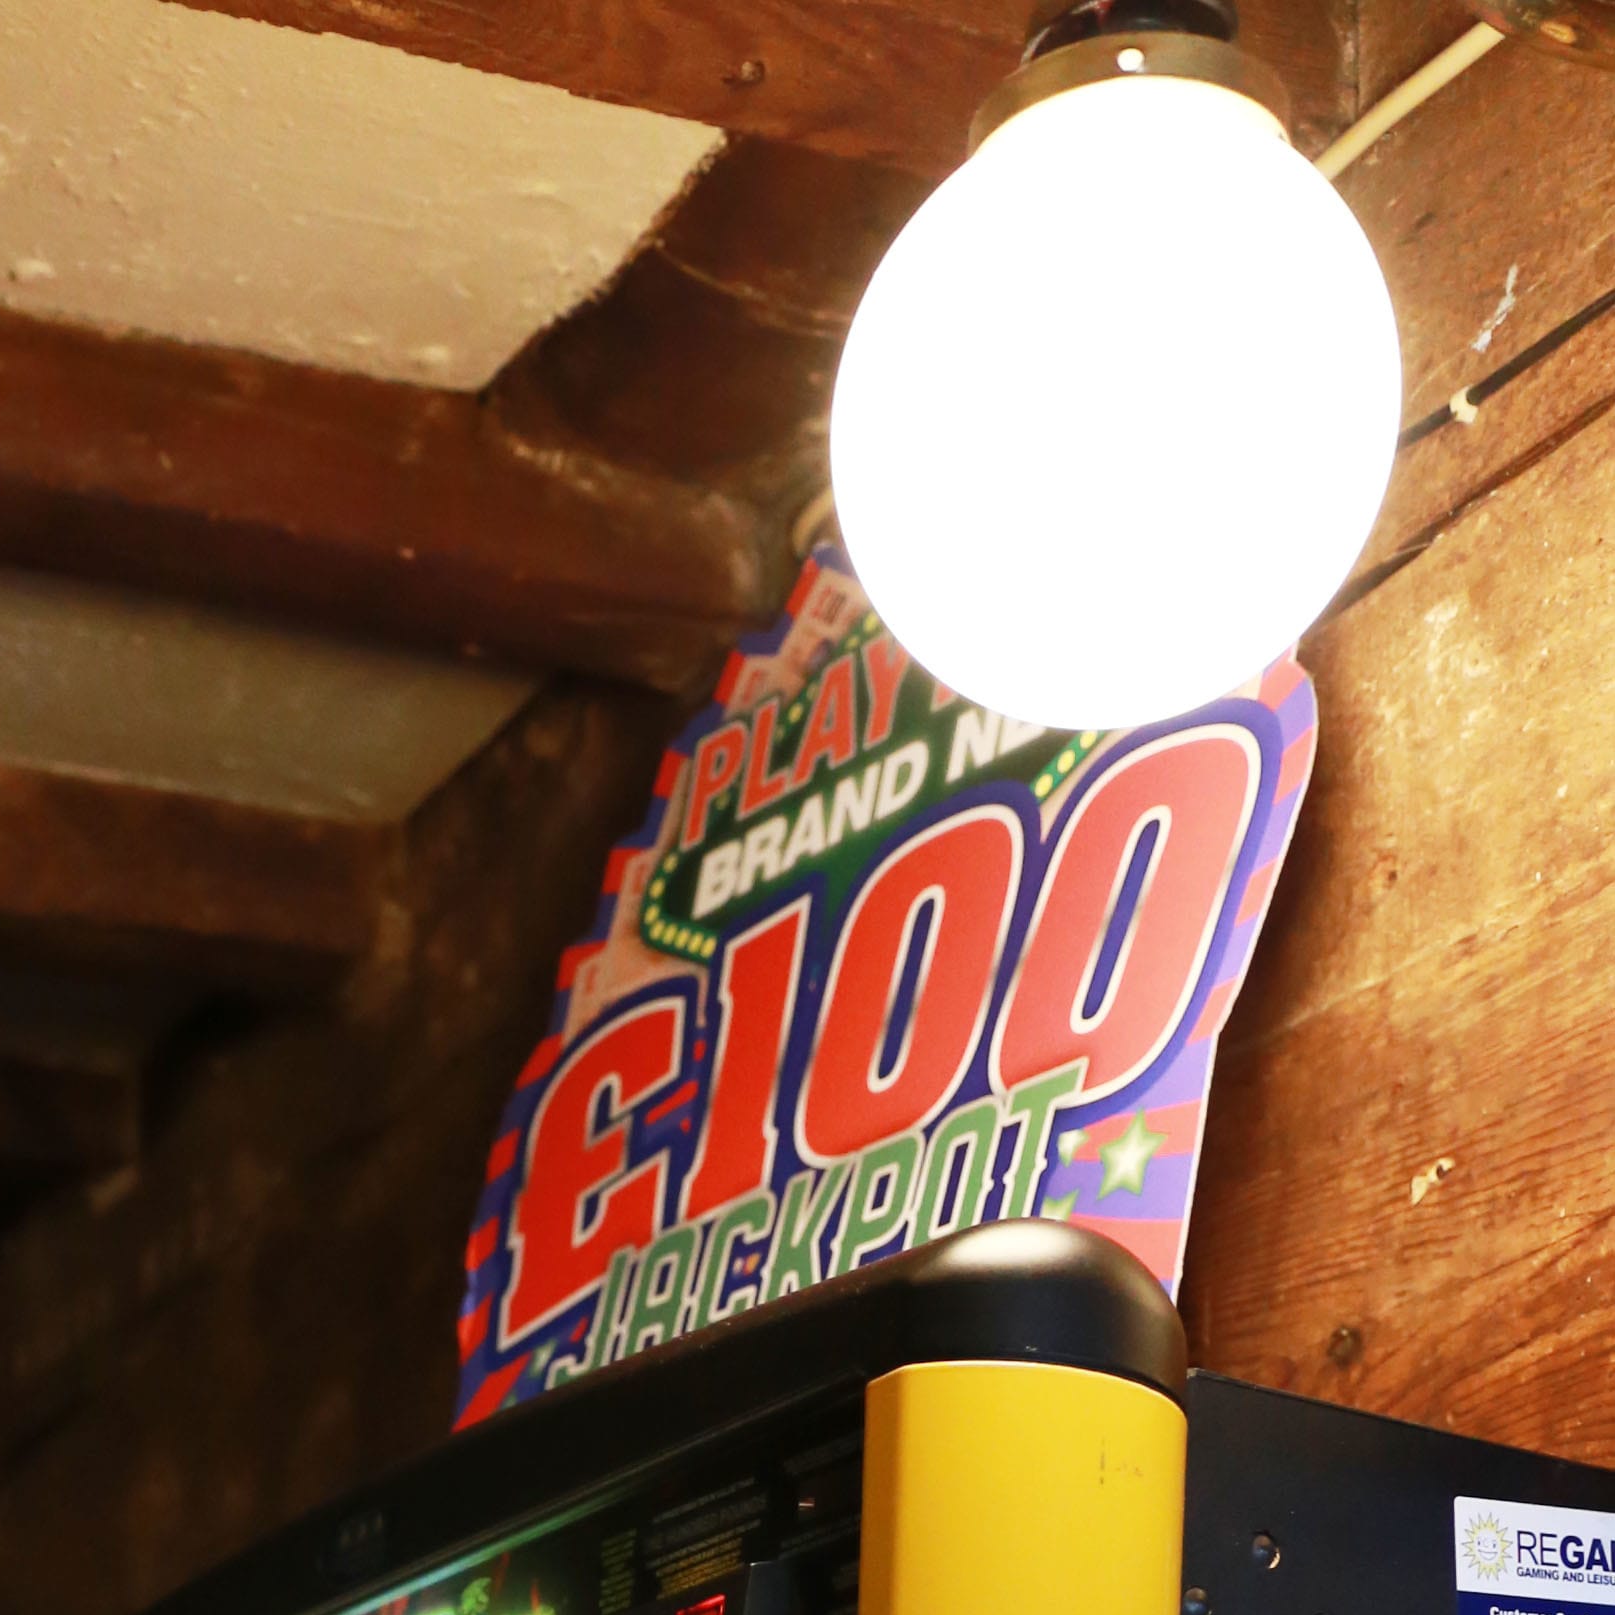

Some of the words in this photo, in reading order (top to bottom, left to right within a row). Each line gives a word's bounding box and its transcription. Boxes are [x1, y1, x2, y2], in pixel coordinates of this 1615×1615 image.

[680, 633, 911, 850] PLAY
[692, 740, 929, 920] BRAND
[497, 722, 1262, 1345] £100
[544, 1058, 1089, 1392] JACKPOT
[1516, 1566, 1560, 1581] GAMING
[1562, 1570, 1585, 1583] AND
